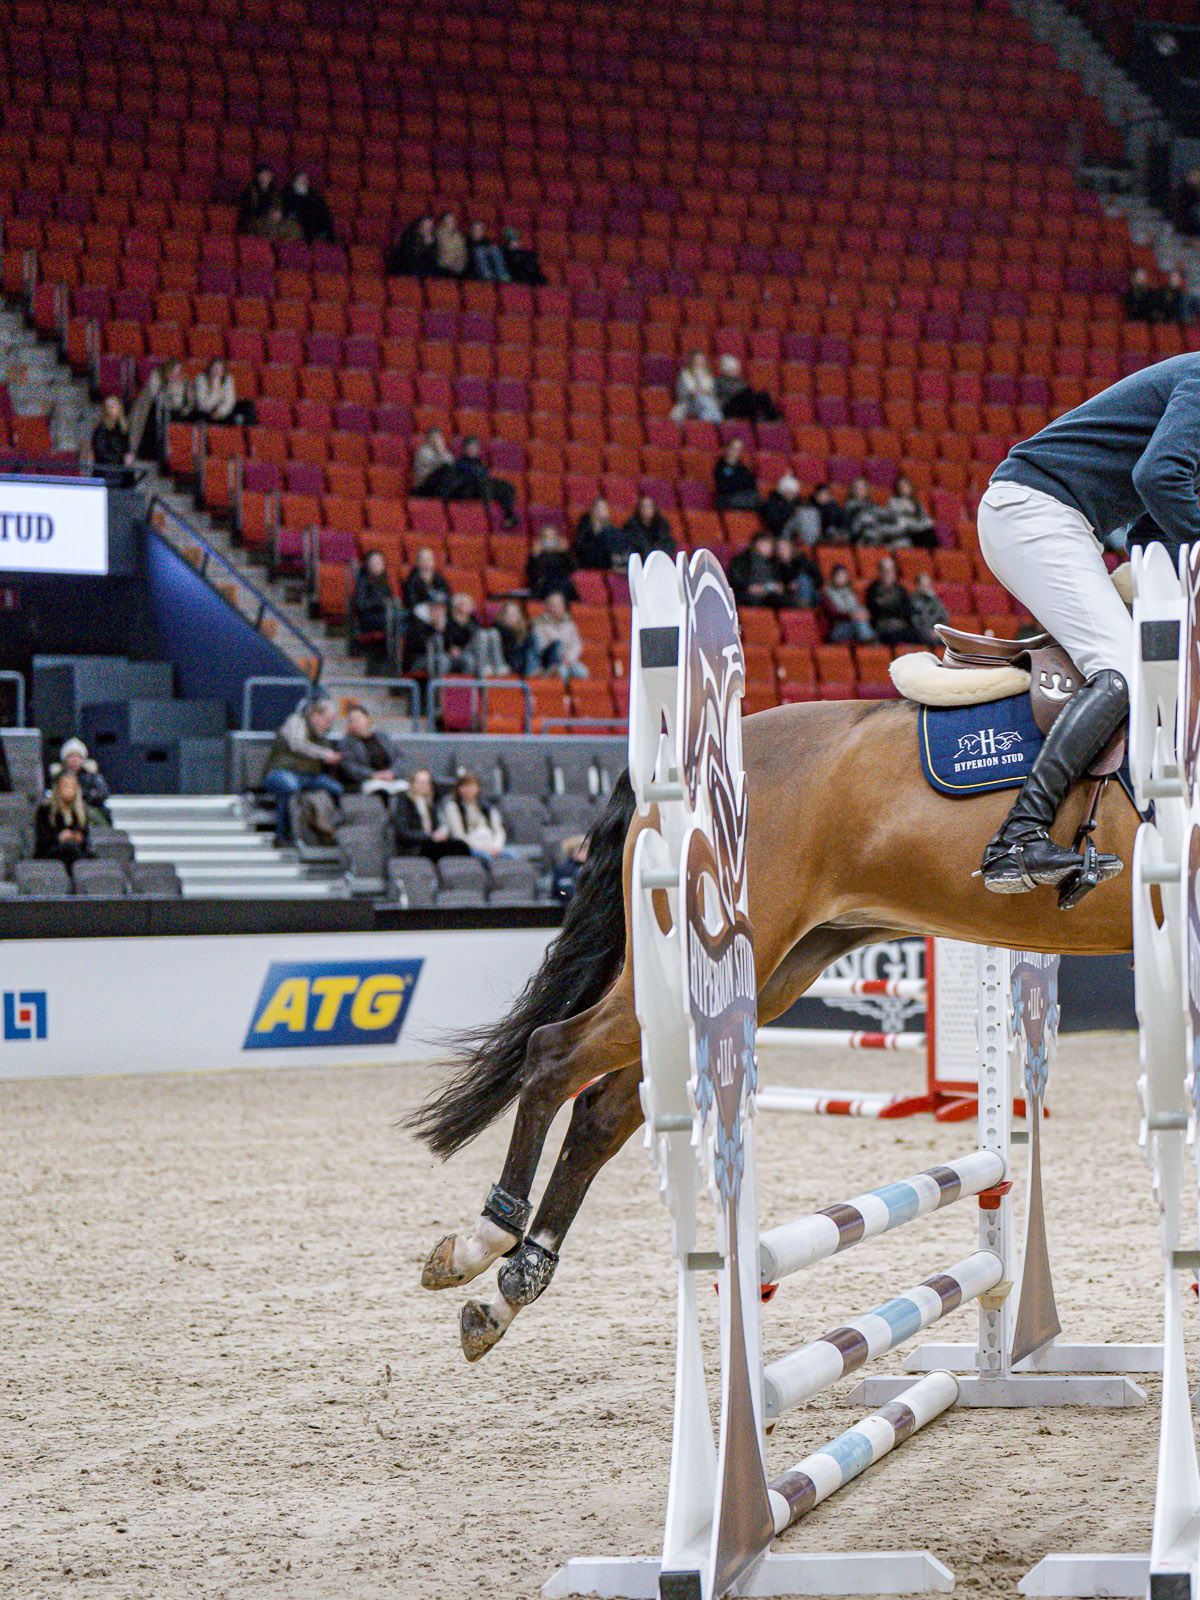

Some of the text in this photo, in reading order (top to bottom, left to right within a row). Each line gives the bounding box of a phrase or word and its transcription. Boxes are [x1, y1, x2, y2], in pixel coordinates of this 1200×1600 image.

[954, 753, 1024, 773] HYPERION STUD
[254, 974, 405, 1033] ATG
